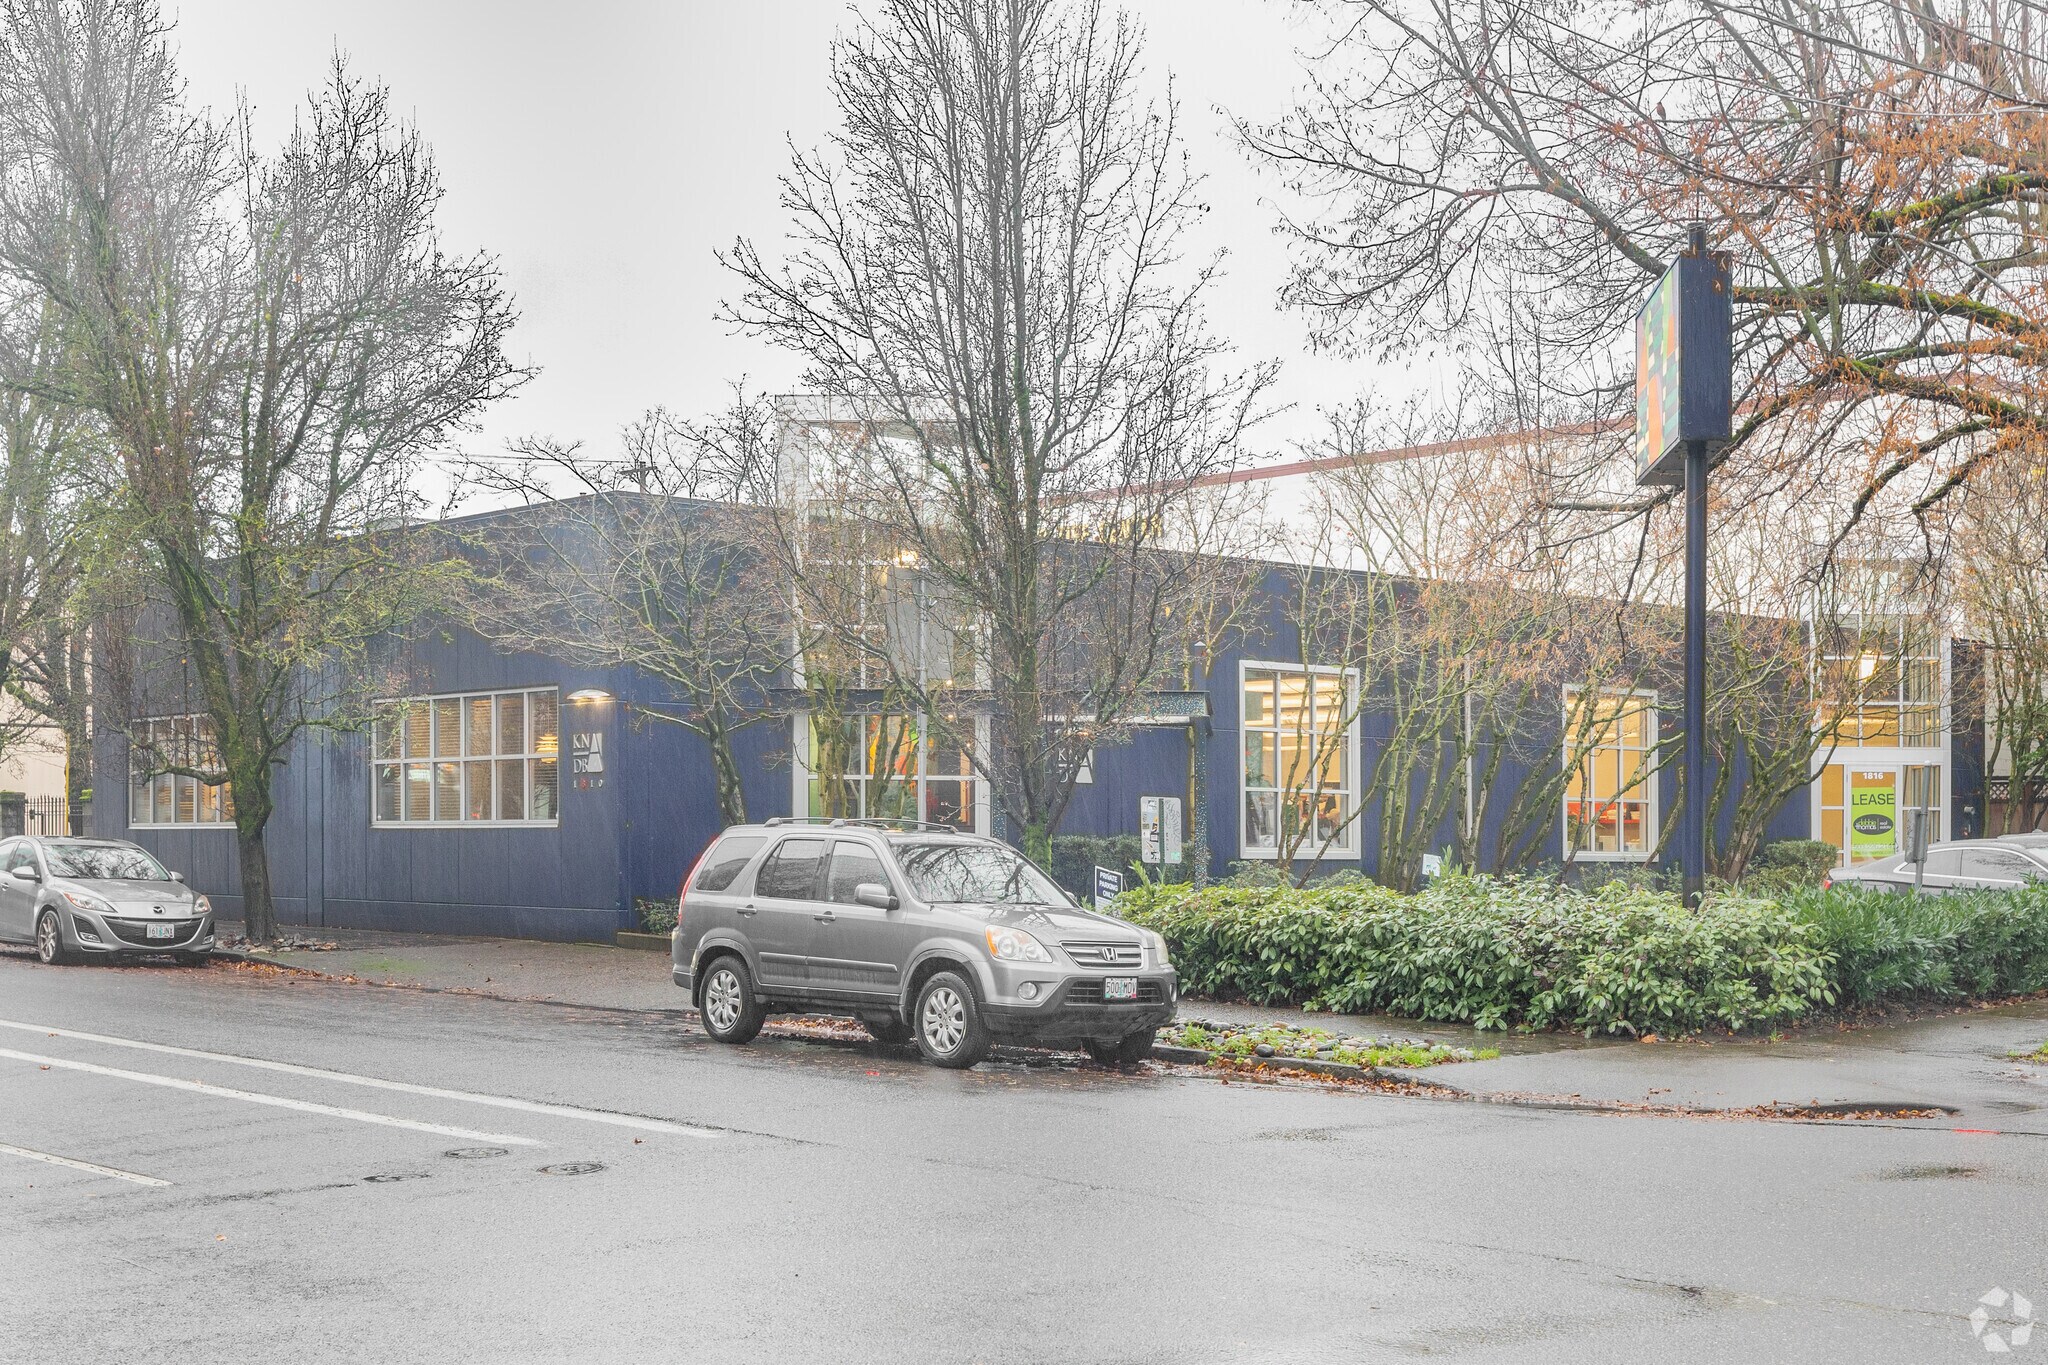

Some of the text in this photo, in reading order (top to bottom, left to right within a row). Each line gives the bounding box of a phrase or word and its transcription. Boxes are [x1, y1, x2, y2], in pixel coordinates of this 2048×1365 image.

[1852, 794, 1895, 805] LEASE
[1099, 871, 1118, 883] PRIVATE
[1098, 879, 1119, 892] PARKING
[1102, 890, 1115, 899] ONLY
[1105, 981, 1120, 994] 500
